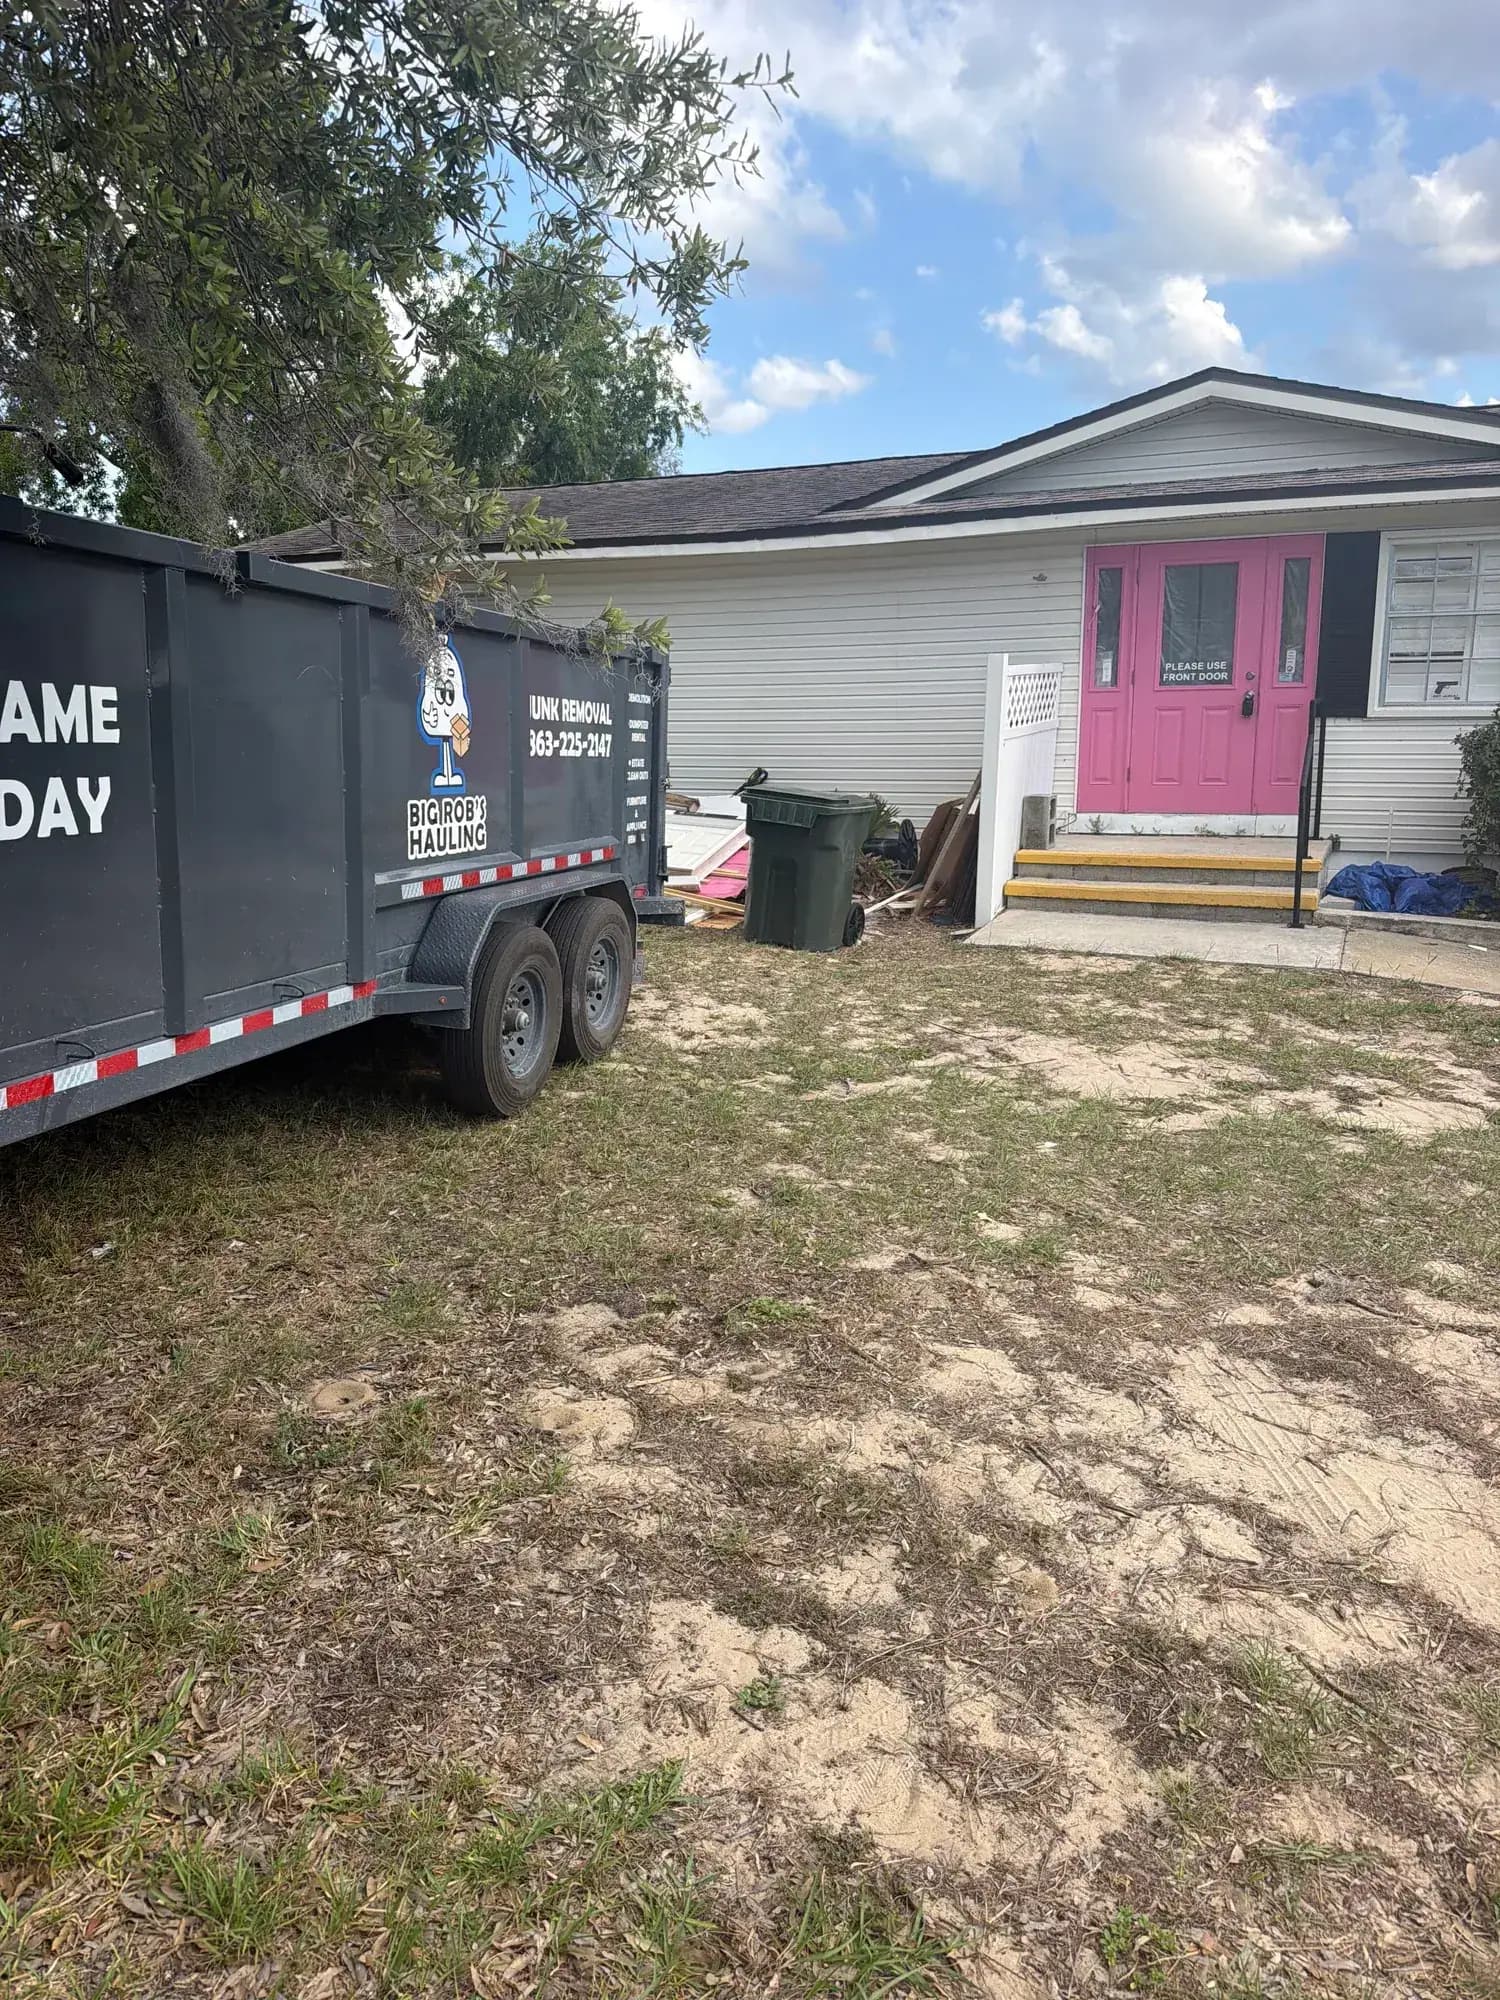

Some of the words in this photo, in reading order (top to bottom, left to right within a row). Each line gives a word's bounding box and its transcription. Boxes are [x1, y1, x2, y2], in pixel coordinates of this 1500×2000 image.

[1163, 673, 1196, 681] FRONT
[1199, 672, 1228, 680] DOOR
[1165, 662, 1204, 671] PLEASE
[1207, 661, 1227, 670] USE
[562, 698, 613, 725] REMOVAL
[0, 776, 111, 841] DAY
[410, 802, 438, 827] BIG
[444, 798, 485, 824] ROB'S
[410, 823, 485, 855] HAULING
